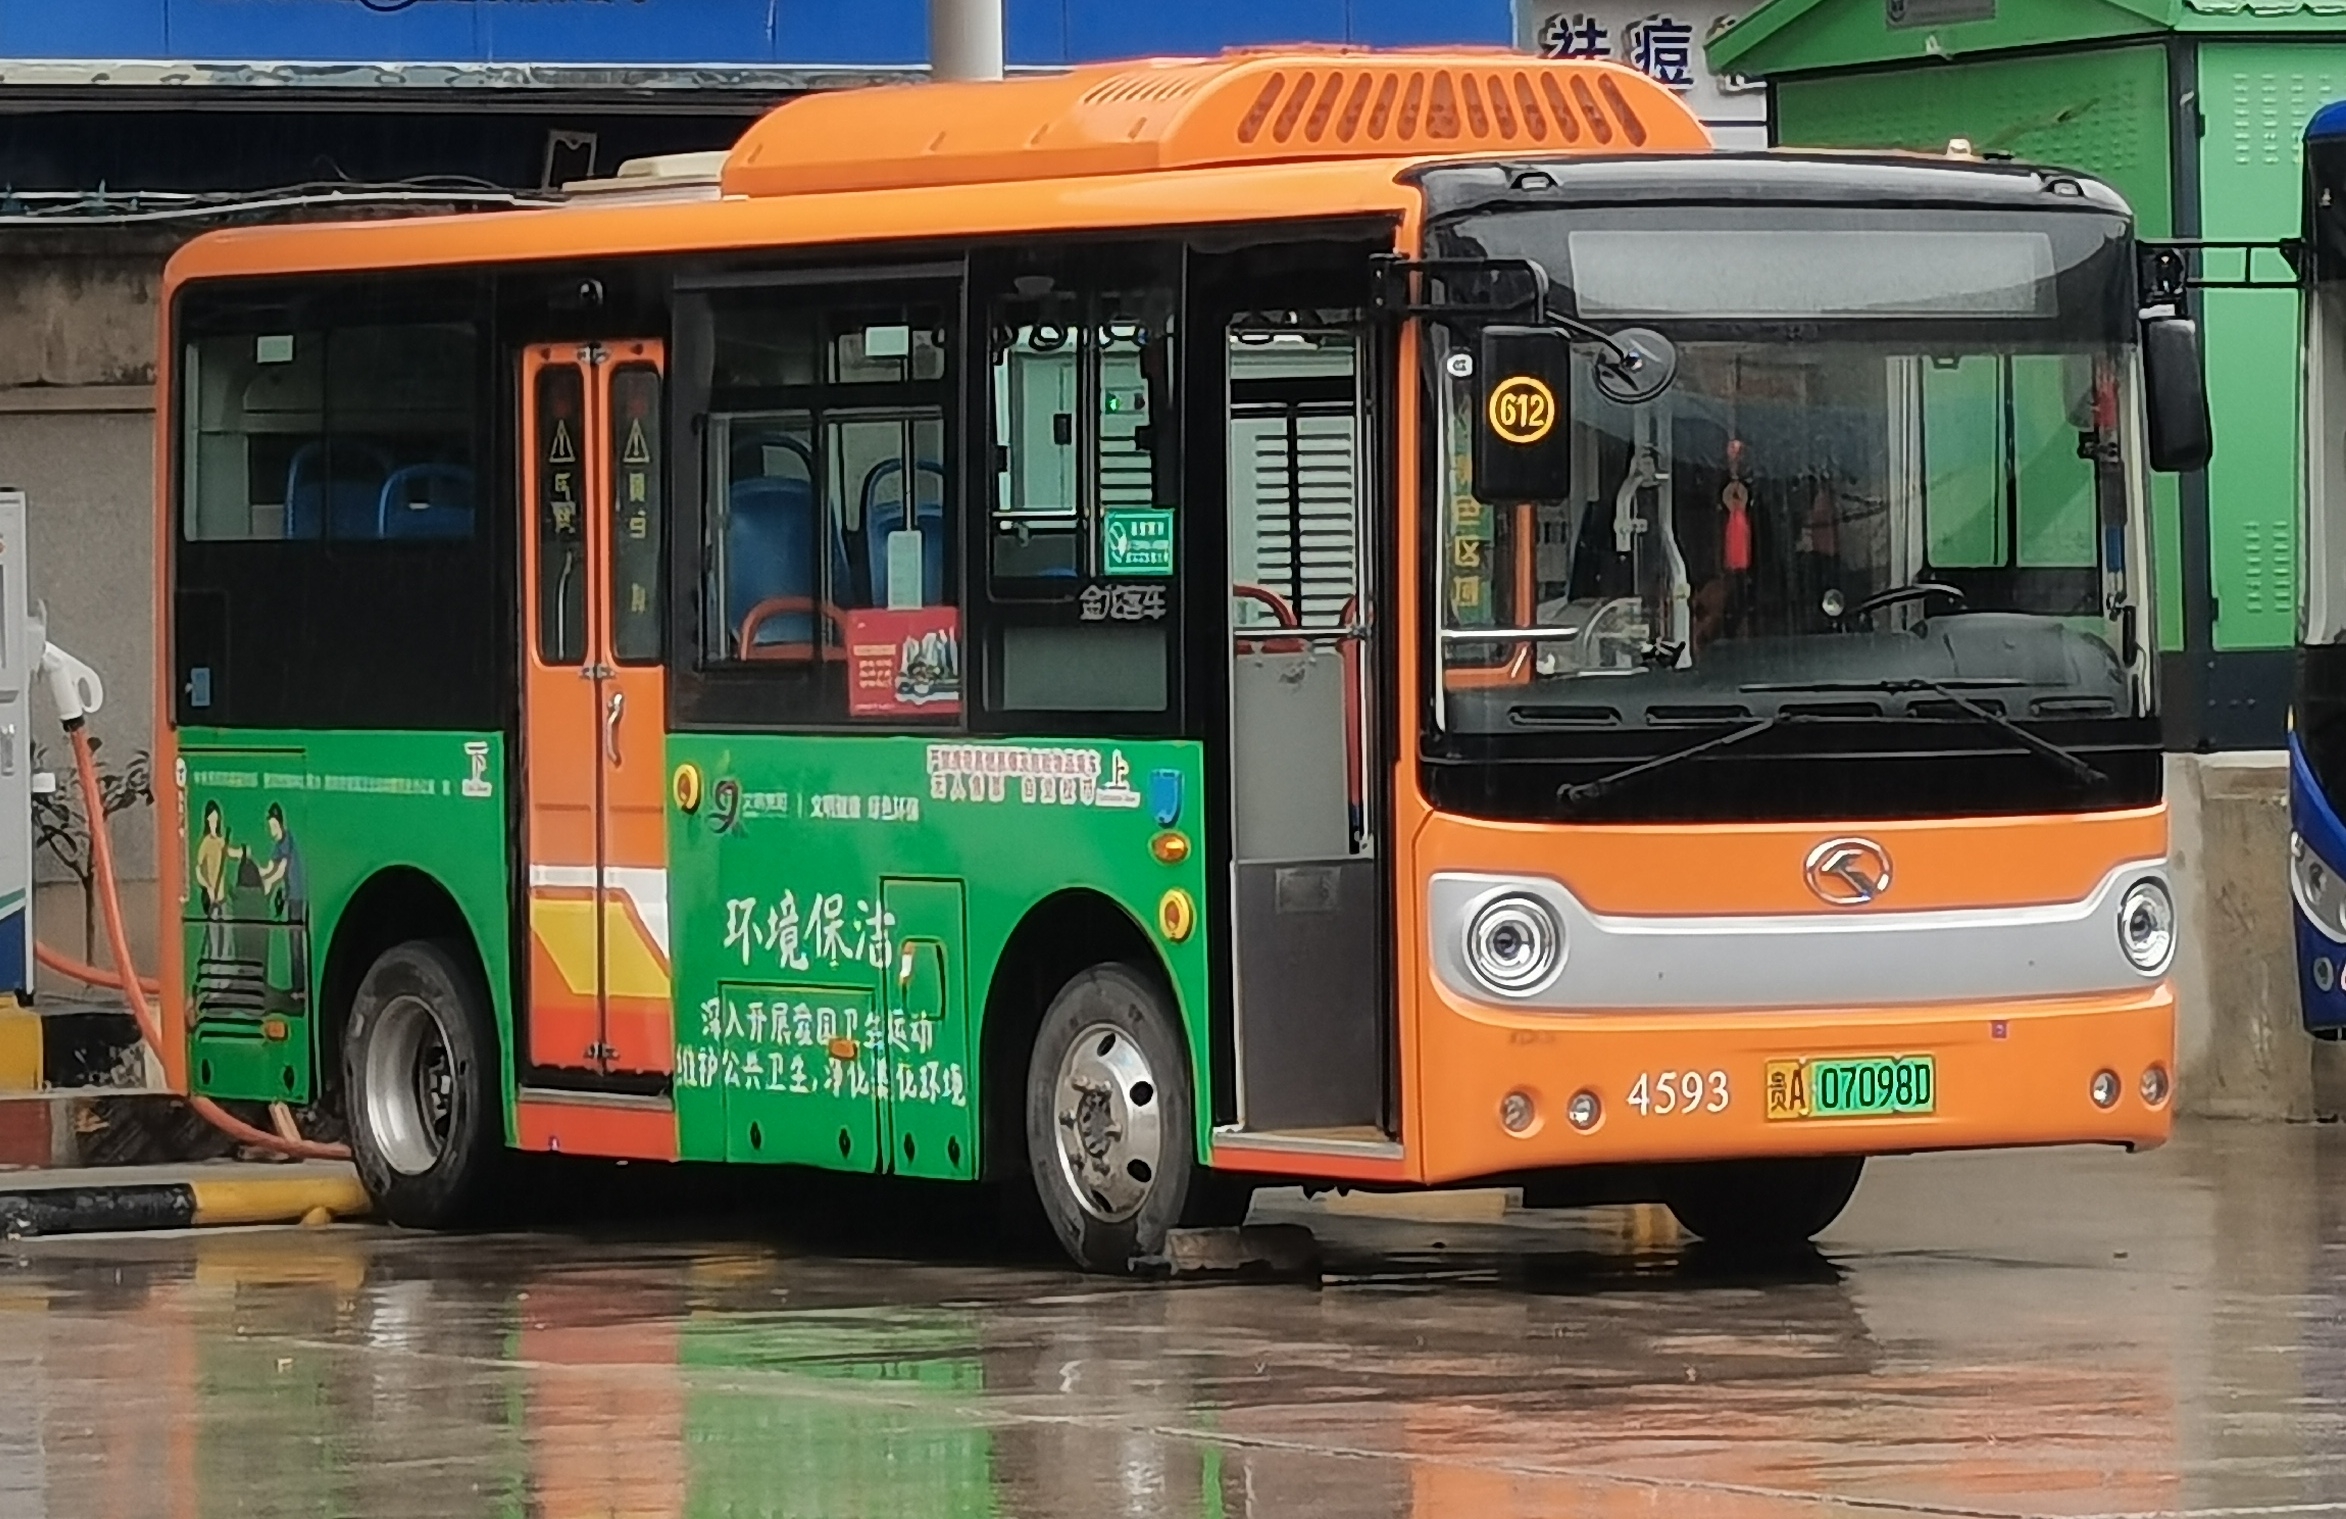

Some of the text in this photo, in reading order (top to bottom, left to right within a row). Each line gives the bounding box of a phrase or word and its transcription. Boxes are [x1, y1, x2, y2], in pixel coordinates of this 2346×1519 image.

[1501, 393, 1545, 427] 612
[724, 888, 896, 971] 环境保洁
[701, 996, 934, 1053] 深入开展爱国卫生运动
[1627, 1070, 1730, 1116] 4593
[1821, 1064, 1931, 1109] 07098D
